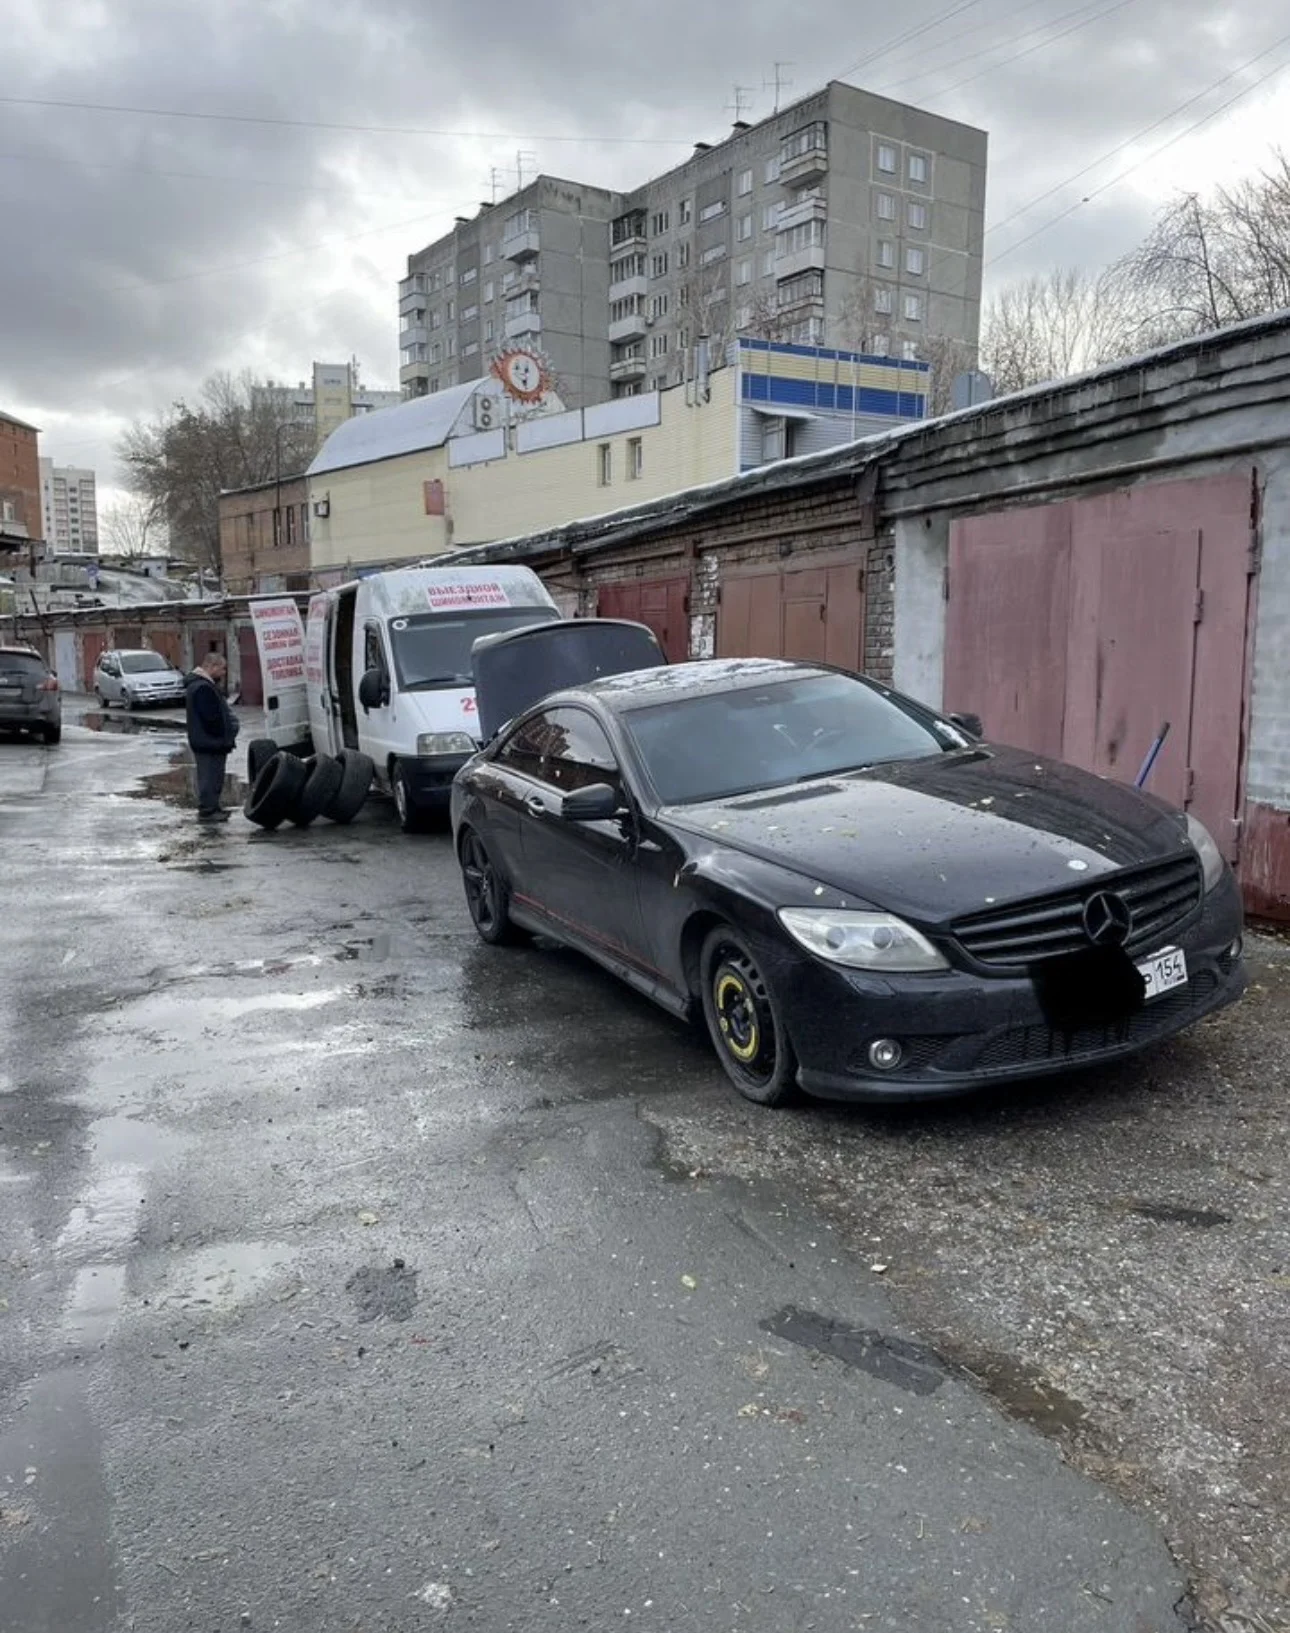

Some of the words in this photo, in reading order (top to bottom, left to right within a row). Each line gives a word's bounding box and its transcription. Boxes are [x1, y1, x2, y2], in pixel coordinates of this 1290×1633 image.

[427, 582, 500, 596] ВЫЕЗДНОЙ
[263, 627, 298, 640] СЕЗОННАЯ
[1155, 955, 1182, 979] 154
